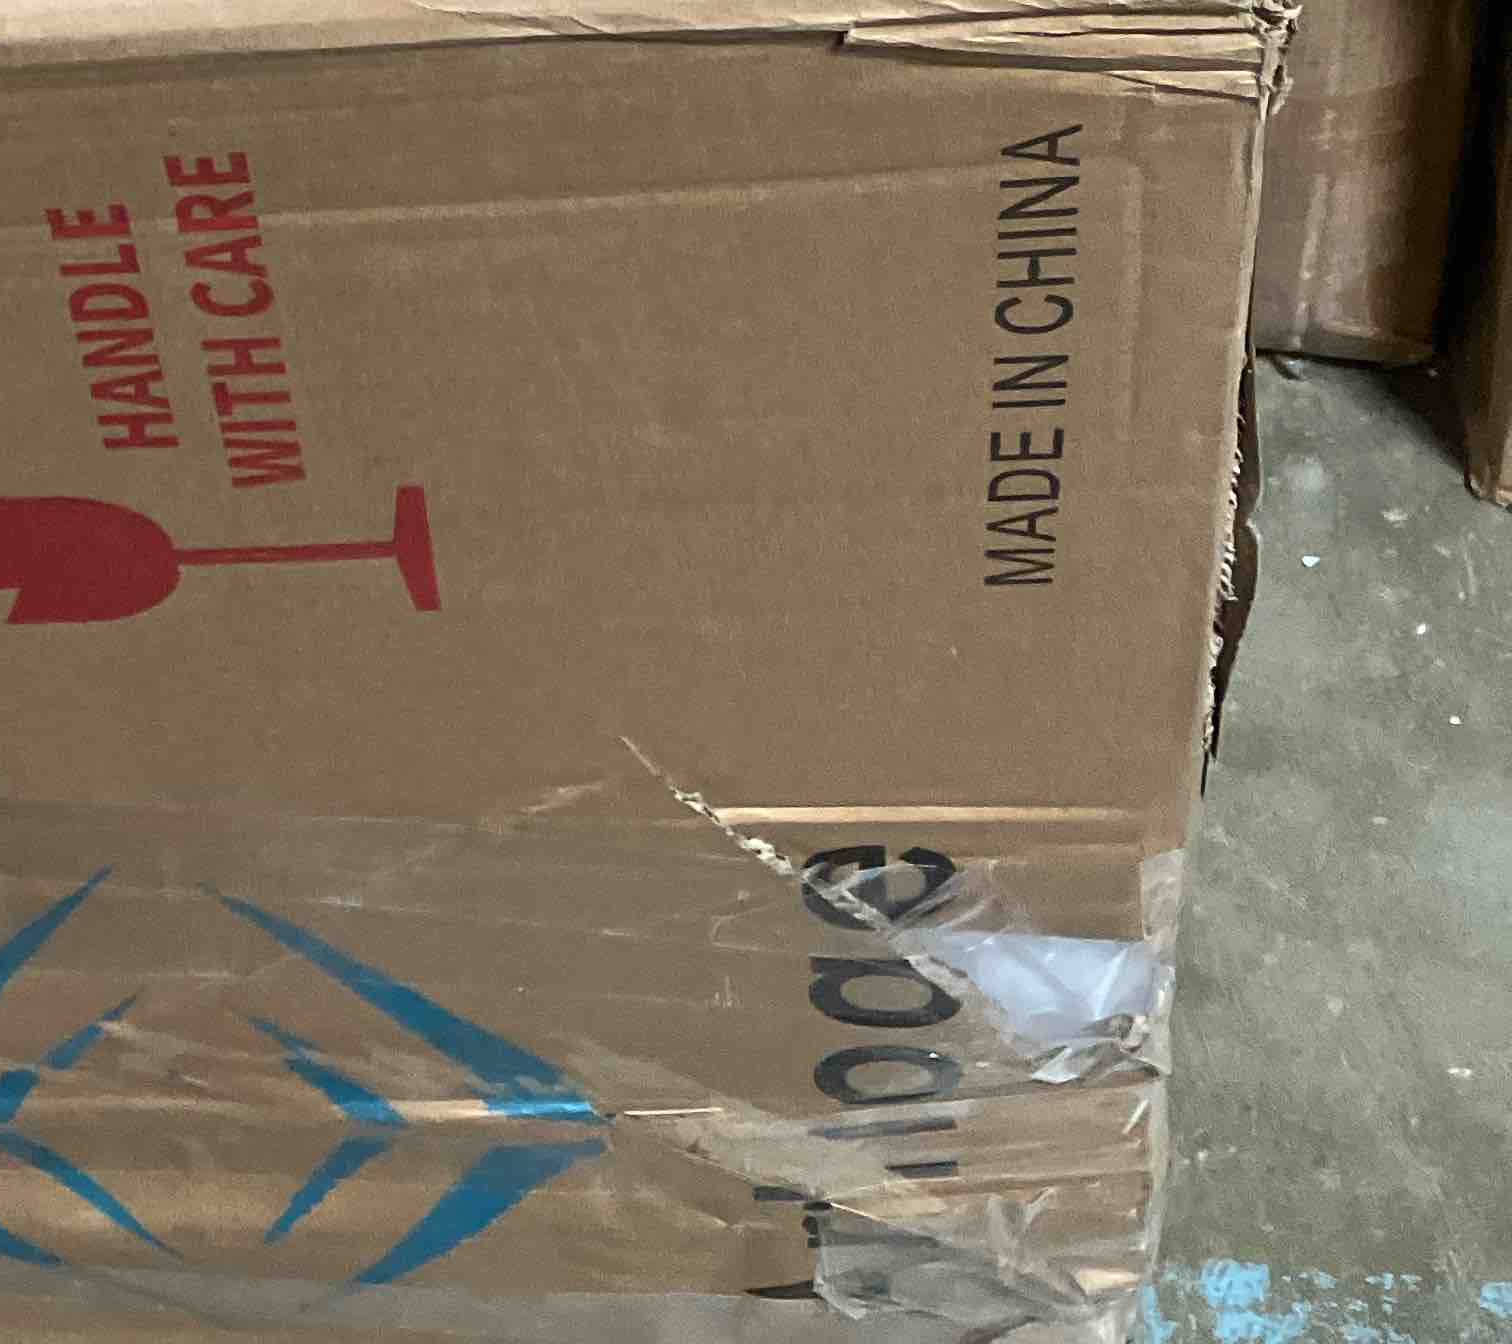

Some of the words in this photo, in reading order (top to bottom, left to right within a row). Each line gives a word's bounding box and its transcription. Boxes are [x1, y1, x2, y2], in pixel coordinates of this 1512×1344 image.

[163, 150, 276, 319] CARE
[993, 123, 1084, 336] CHINA
[45, 202, 179, 449] HANDLE
[991, 354, 1070, 410] IN
[200, 336, 307, 489] WITH
[983, 428, 1065, 587] MADE
